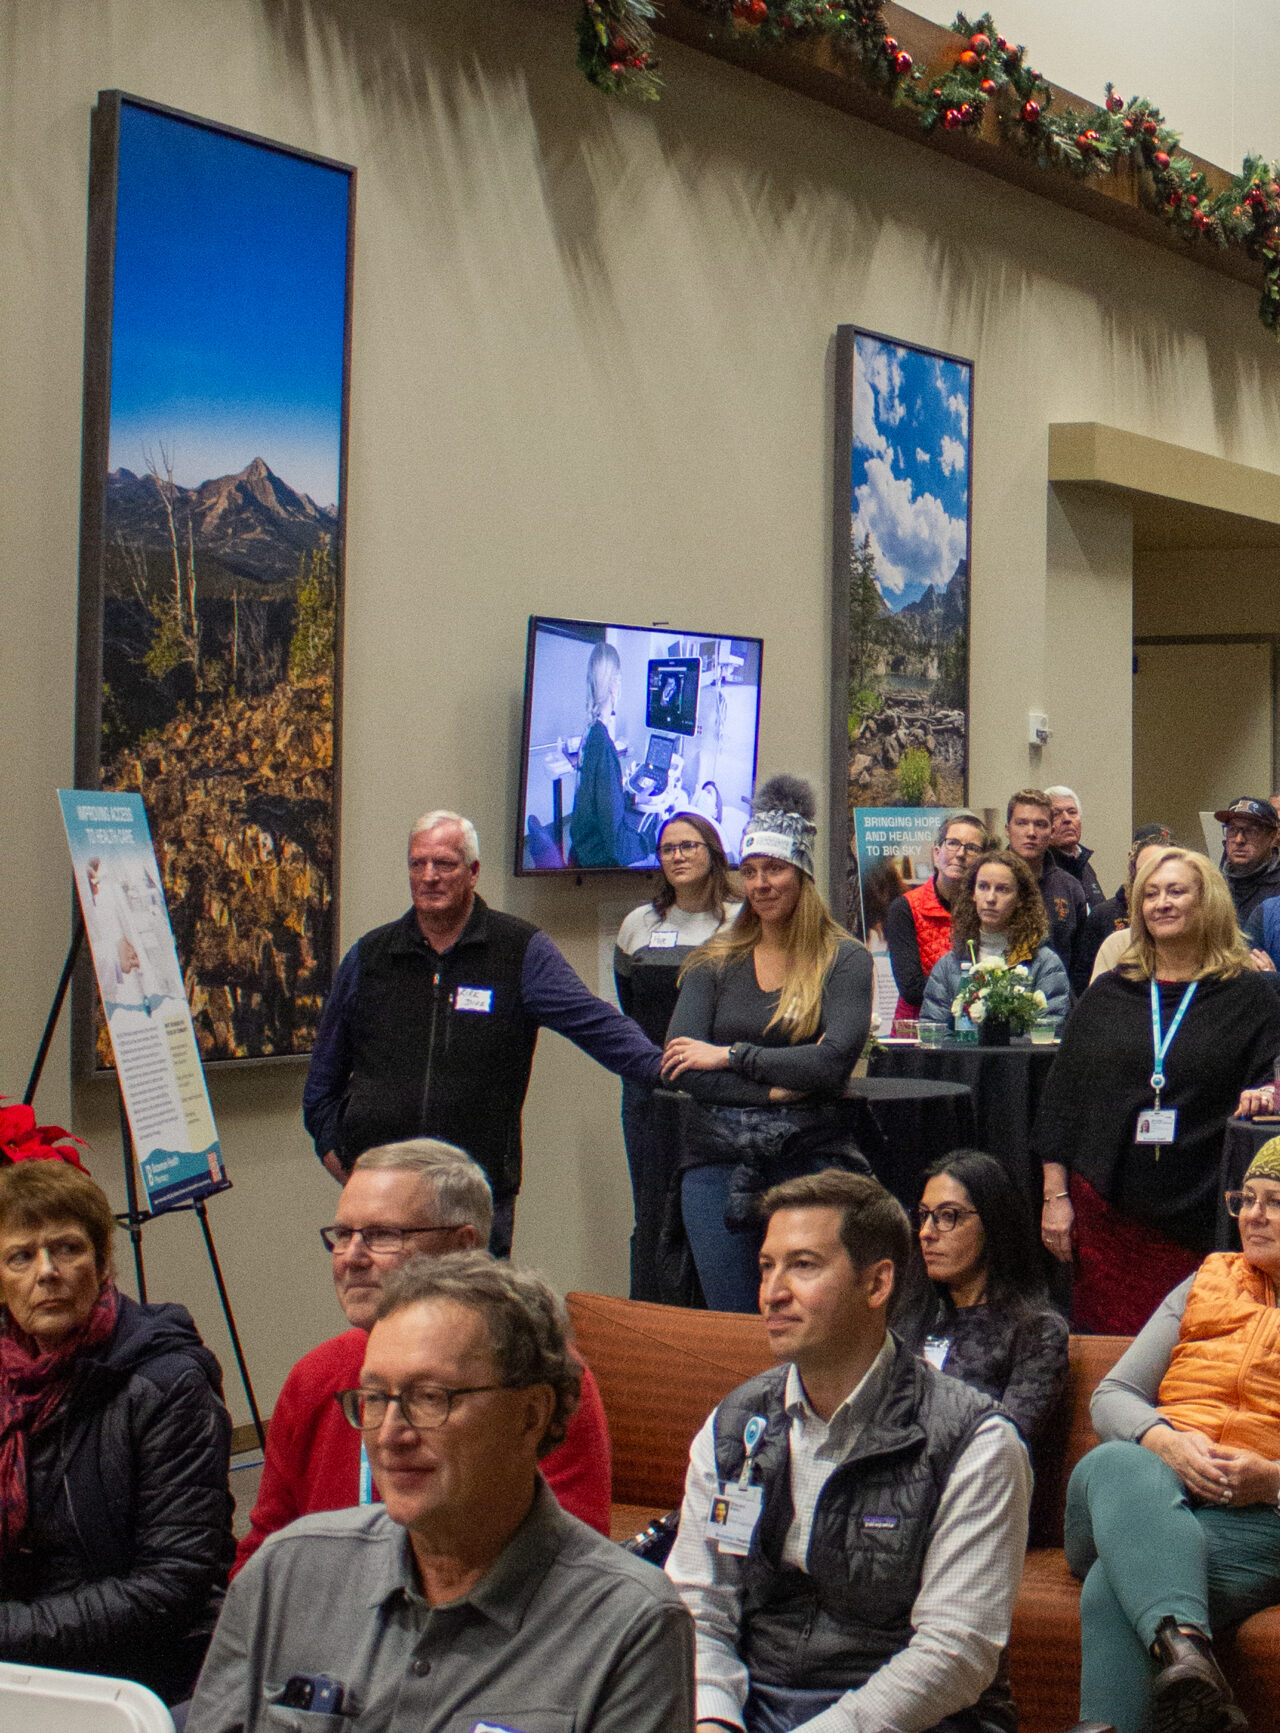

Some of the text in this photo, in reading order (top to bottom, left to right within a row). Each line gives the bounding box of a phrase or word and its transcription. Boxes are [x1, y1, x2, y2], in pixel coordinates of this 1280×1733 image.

[864, 816, 941, 827] BRINGING HOPE
[865, 831, 932, 841] AND HEALING
[866, 845, 922, 856] TO BIG SKY
